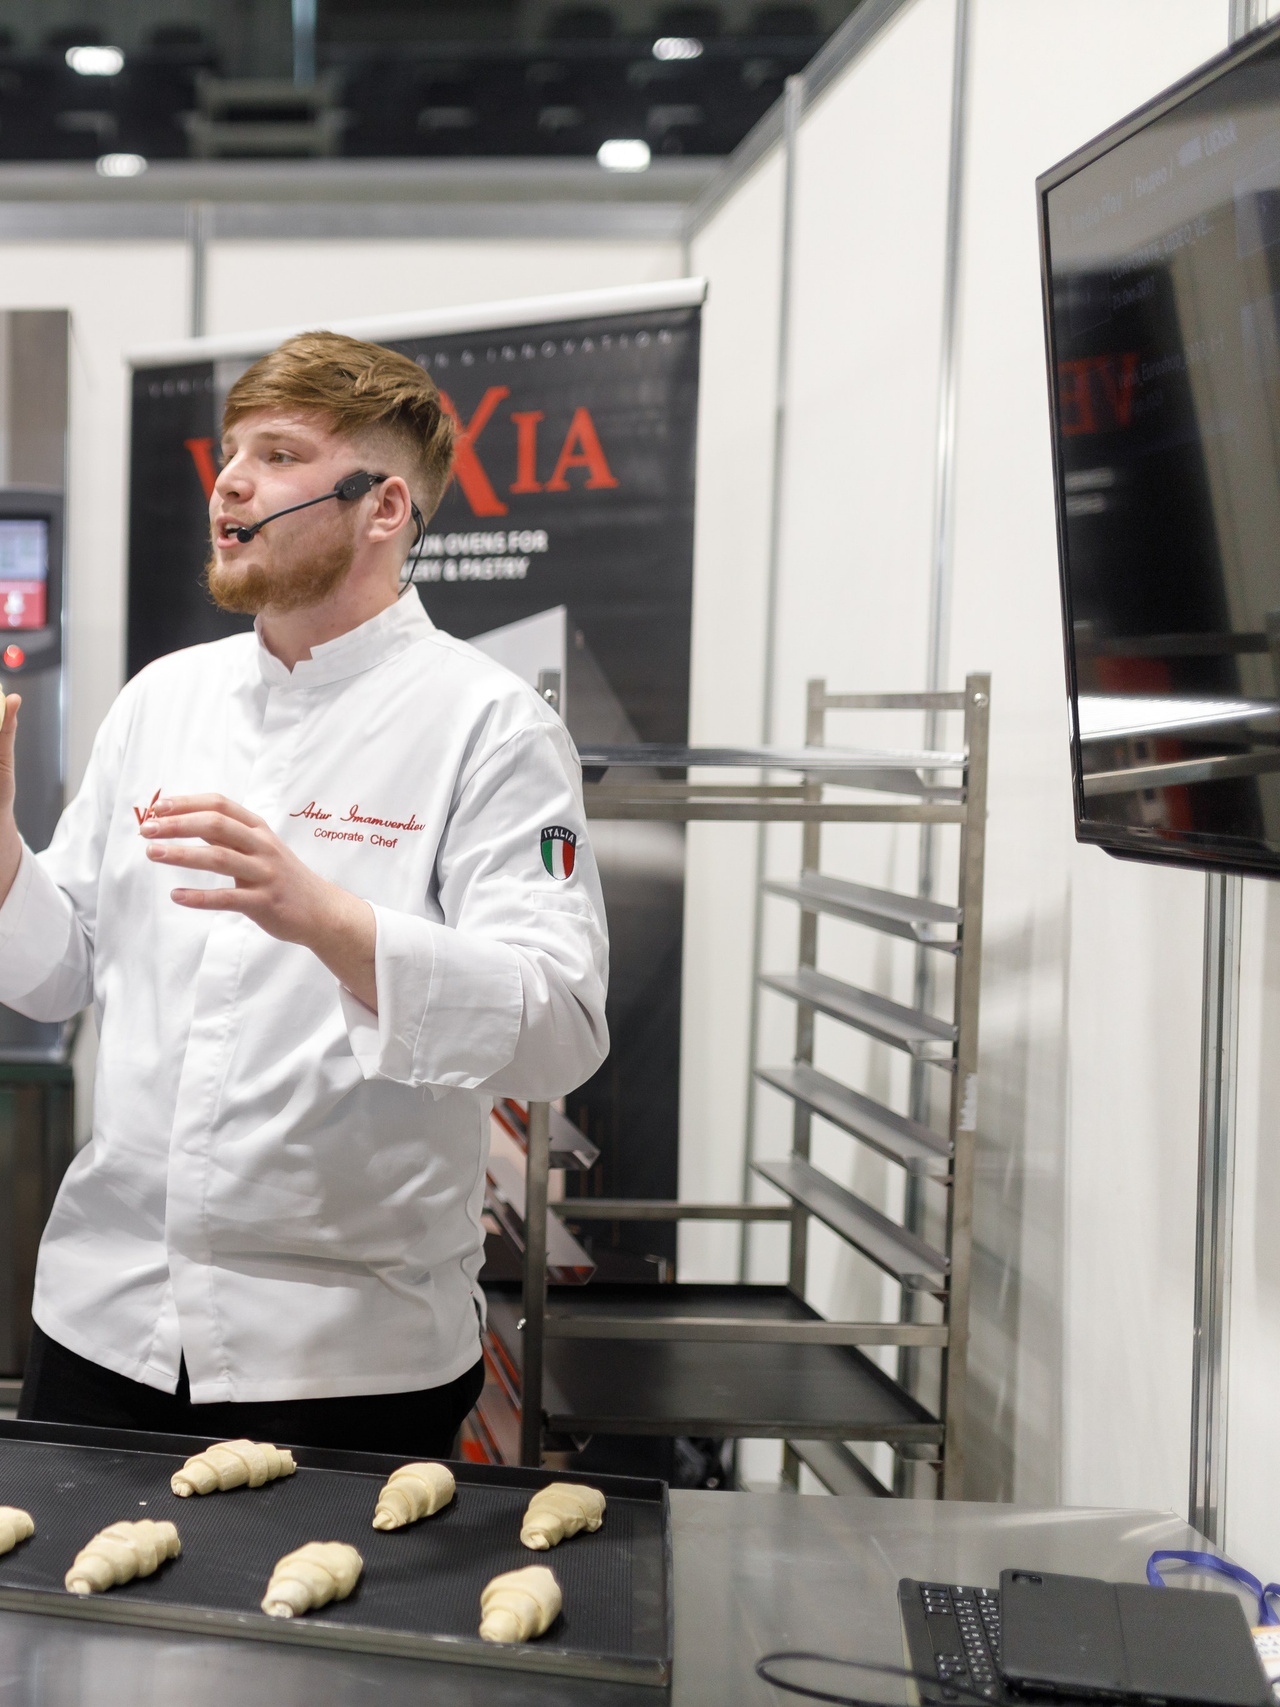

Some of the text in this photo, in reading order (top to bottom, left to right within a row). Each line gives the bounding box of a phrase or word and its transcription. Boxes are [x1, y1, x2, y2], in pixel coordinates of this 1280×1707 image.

[444, 531, 507, 556] OVENS
[508, 529, 549, 553] FOR
[459, 556, 530, 581] PASTRY
[289, 801, 332, 820] Artur
[313, 828, 398, 848] Corporate Chef
[543, 828, 574, 843] ITALIA
